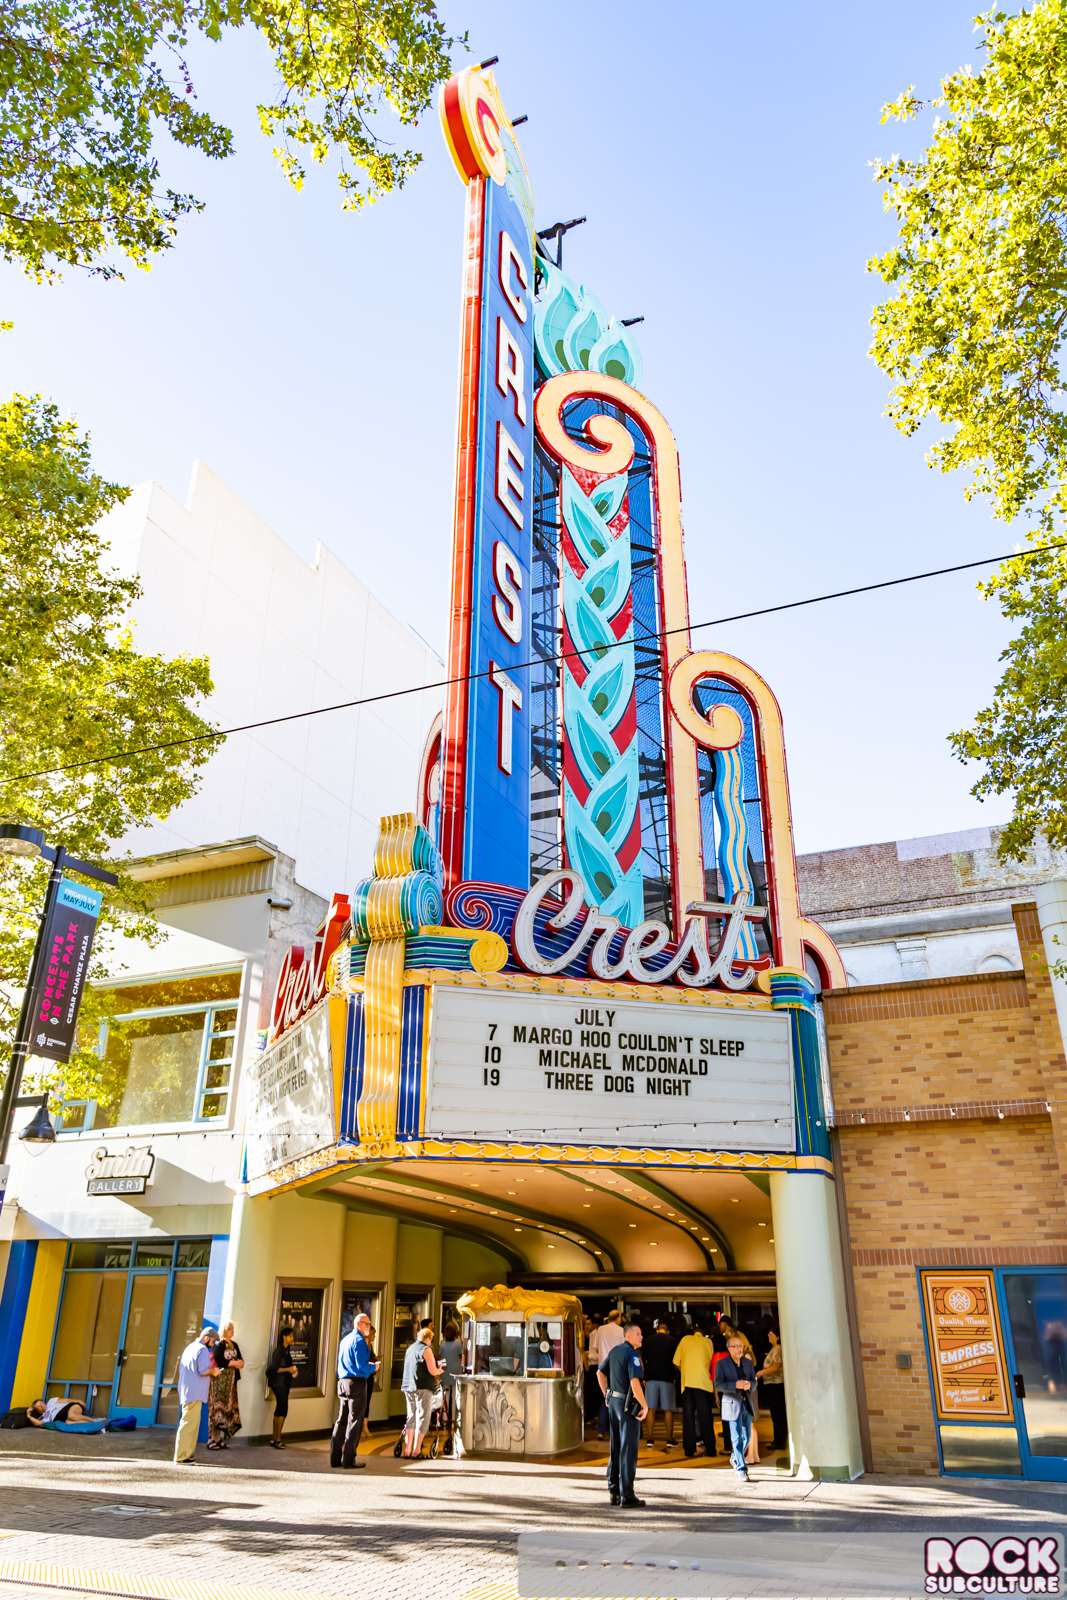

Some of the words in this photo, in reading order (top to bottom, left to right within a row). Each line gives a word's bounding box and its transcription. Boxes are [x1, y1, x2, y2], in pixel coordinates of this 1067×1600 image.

[487, 230, 527, 777] CREST
[64, 888, 87, 902] FRIDAYS
[87, 897, 97, 905] 5-9
[62, 921, 79, 965] PARK
[511, 869, 769, 991] Crest
[40, 935, 64, 1022] CONCERTS
[55, 965, 70, 1000] THE
[66, 998, 77, 1025] CESAR
[72, 962, 84, 996] CHAVEZ
[79, 935, 90, 961] PLAZA
[575, 1008, 616, 1027] JULY
[488, 1024, 498, 1041] 7
[513, 1025, 573, 1046] MARGO
[580, 1030, 611, 1049] HOO
[618, 1033, 694, 1054] COULDN'T
[700, 1038, 745, 1057] SLEEP
[484, 1046, 501, 1064] 10
[539, 1049, 612, 1070] MICHAEL
[622, 1054, 708, 1076] MCDONALD
[292, 1066, 308, 1093] FEVER
[483, 1068, 500, 1086] 19
[544, 1071, 594, 1091] THREE
[604, 1075, 635, 1093] DOG
[646, 1077, 691, 1096] NIGHT
[85, 1146, 154, 1180] Smith
[88, 1180, 141, 1192] GALLERY
[146, 1257, 162, 1267] 1011
[939, 1317, 963, 1326] Quality
[964, 1317, 988, 1325] Meats
[940, 1342, 995, 1364] EMPRESS
[954, 1358, 982, 1370] TAVERN
